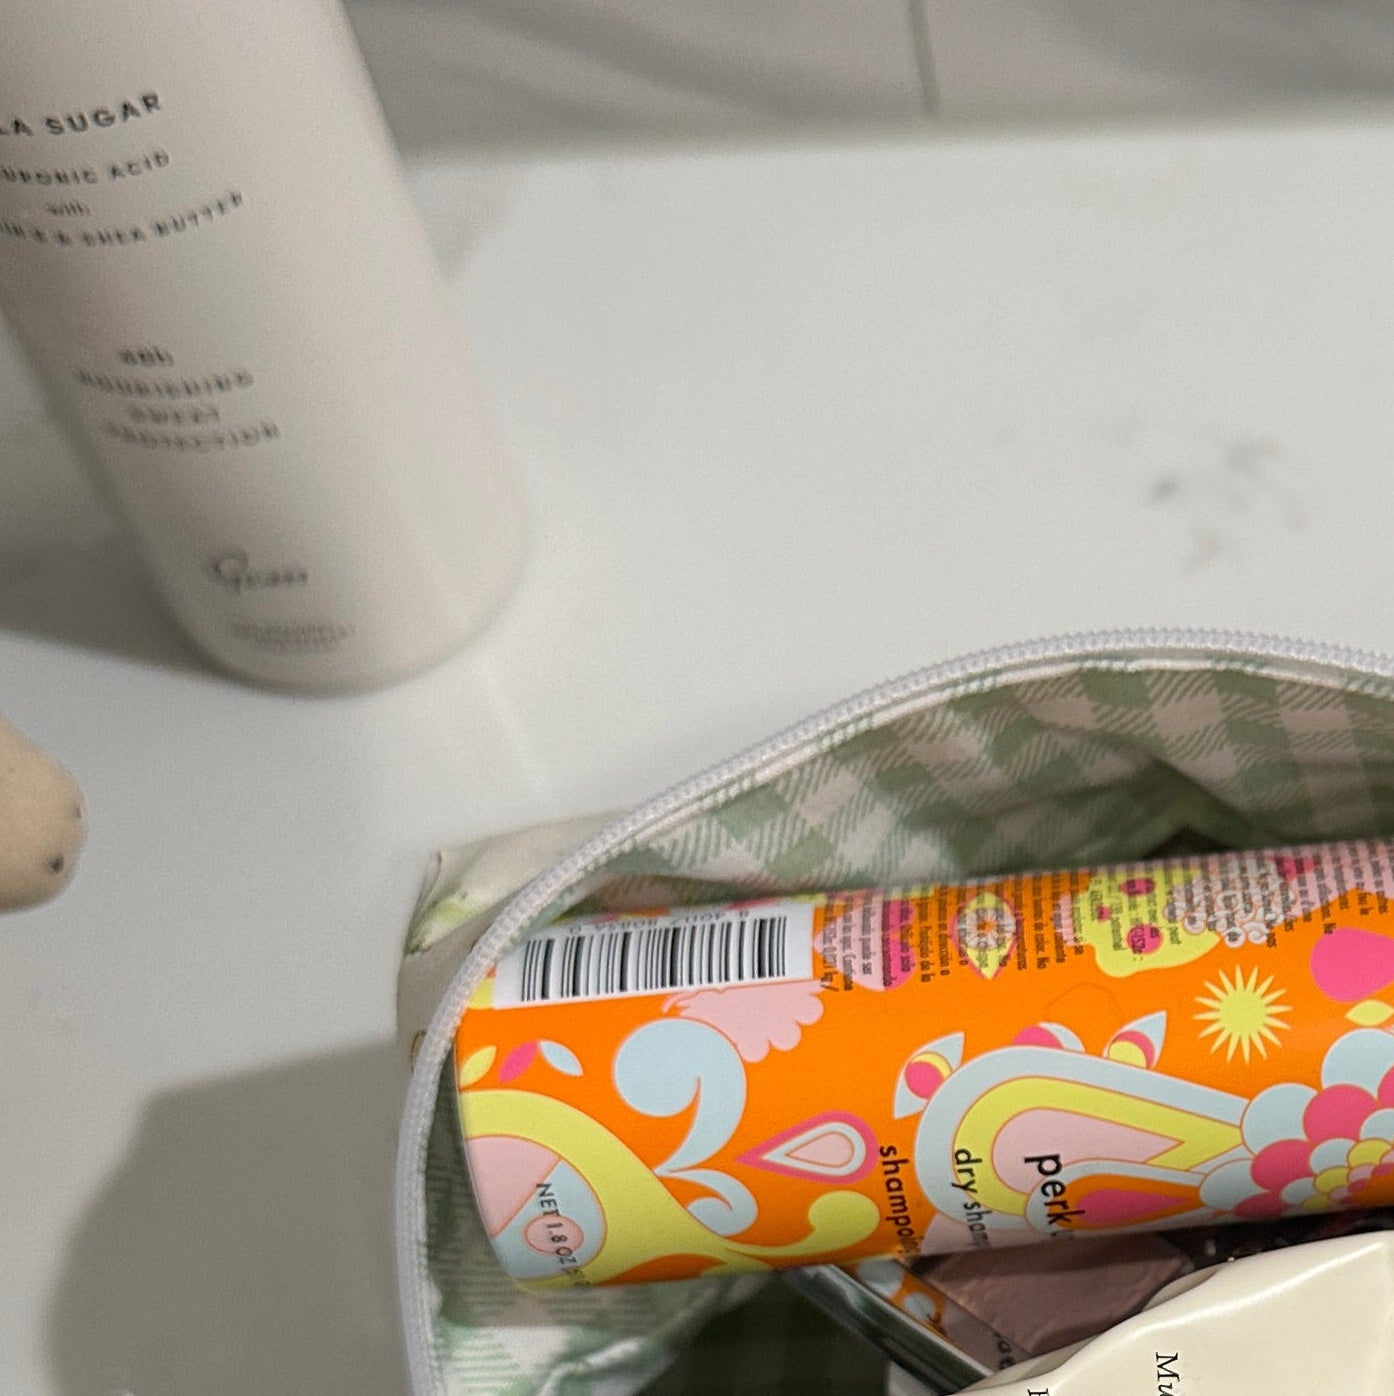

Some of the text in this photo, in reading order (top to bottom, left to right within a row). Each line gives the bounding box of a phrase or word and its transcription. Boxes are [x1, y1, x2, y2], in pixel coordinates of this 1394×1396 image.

[45, 92, 161, 135] SUGAR
[1036, 957, 1049, 969] No
[950, 1149, 982, 1194] dry
[535, 1183, 559, 1216] NET
[1023, 1155, 1085, 1225] perk
[545, 1223, 567, 1243] 1.8
[555, 1246, 576, 1265] OZ
